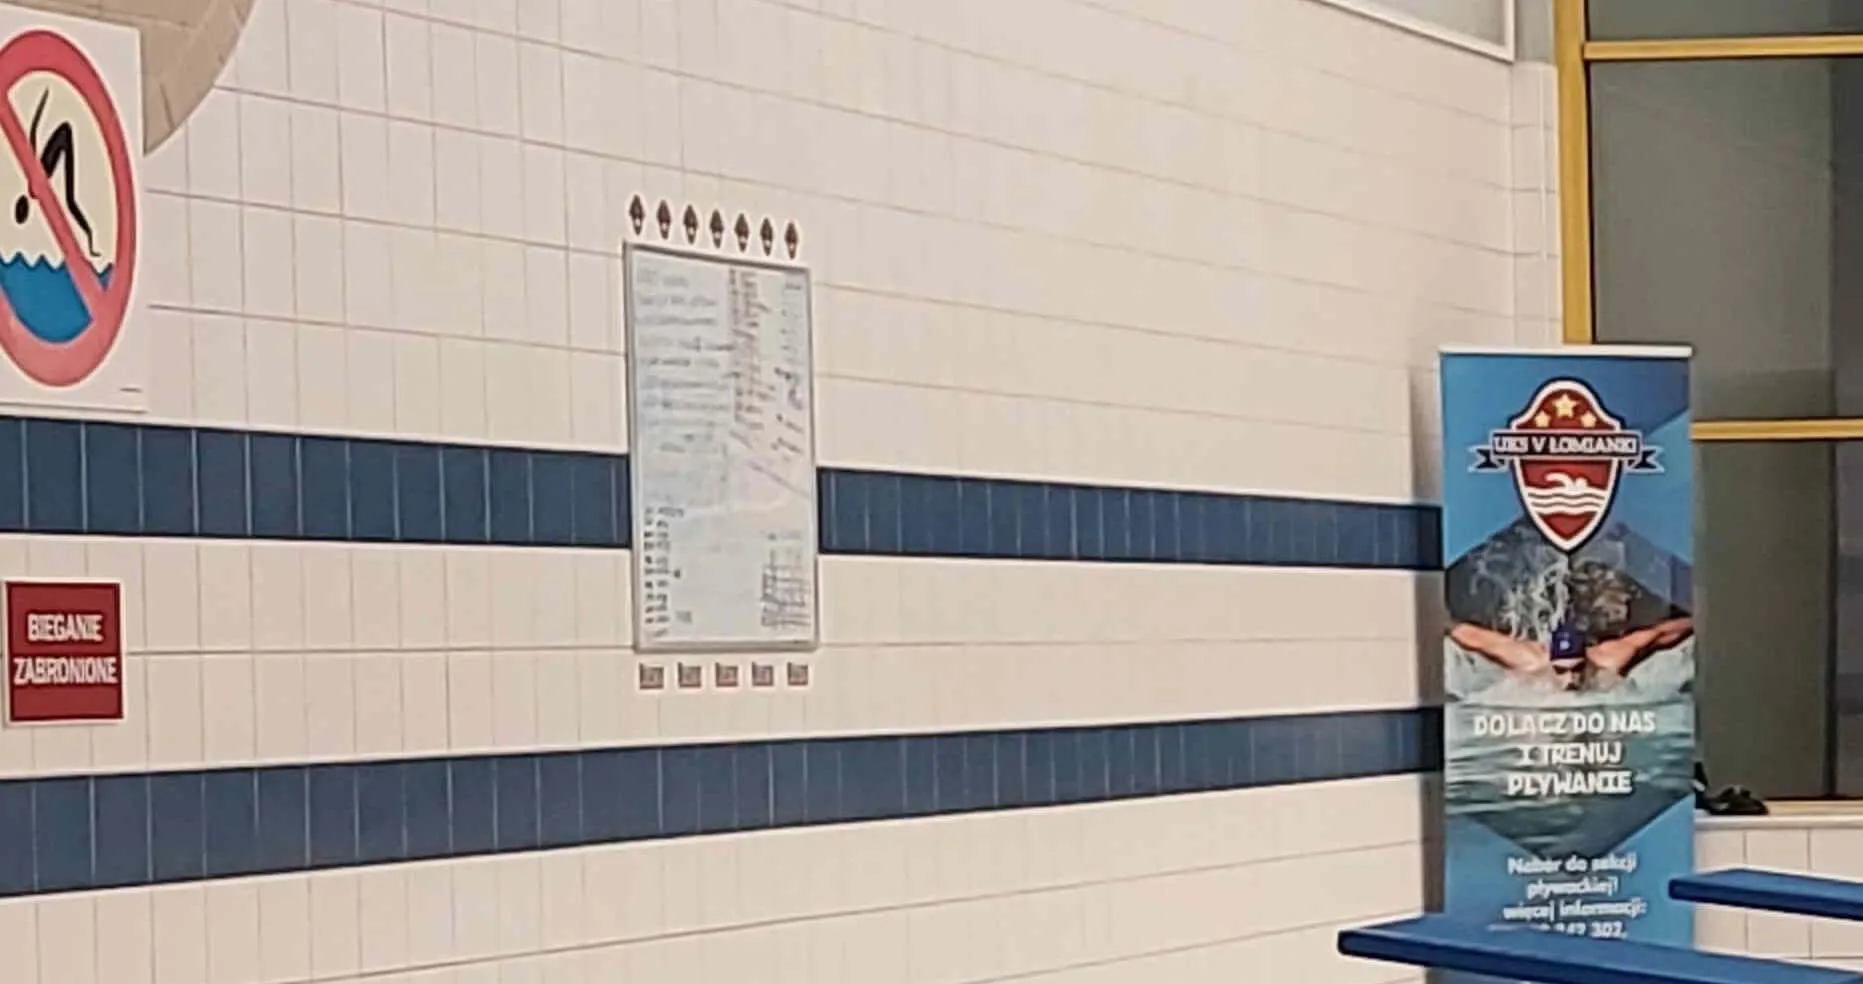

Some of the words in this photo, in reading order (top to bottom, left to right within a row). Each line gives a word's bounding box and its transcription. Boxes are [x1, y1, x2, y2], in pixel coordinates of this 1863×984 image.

[1531, 436, 1547, 453] V
[27, 613, 104, 642] BIEGANIE
[13, 656, 118, 686] ZABRONIONE
[1573, 712, 1605, 735] DO
[1610, 710, 1656, 733] NAS
[1515, 745, 1535, 767] I
[1540, 742, 1623, 766] TRENUJ
[1565, 854, 1588, 872] do
